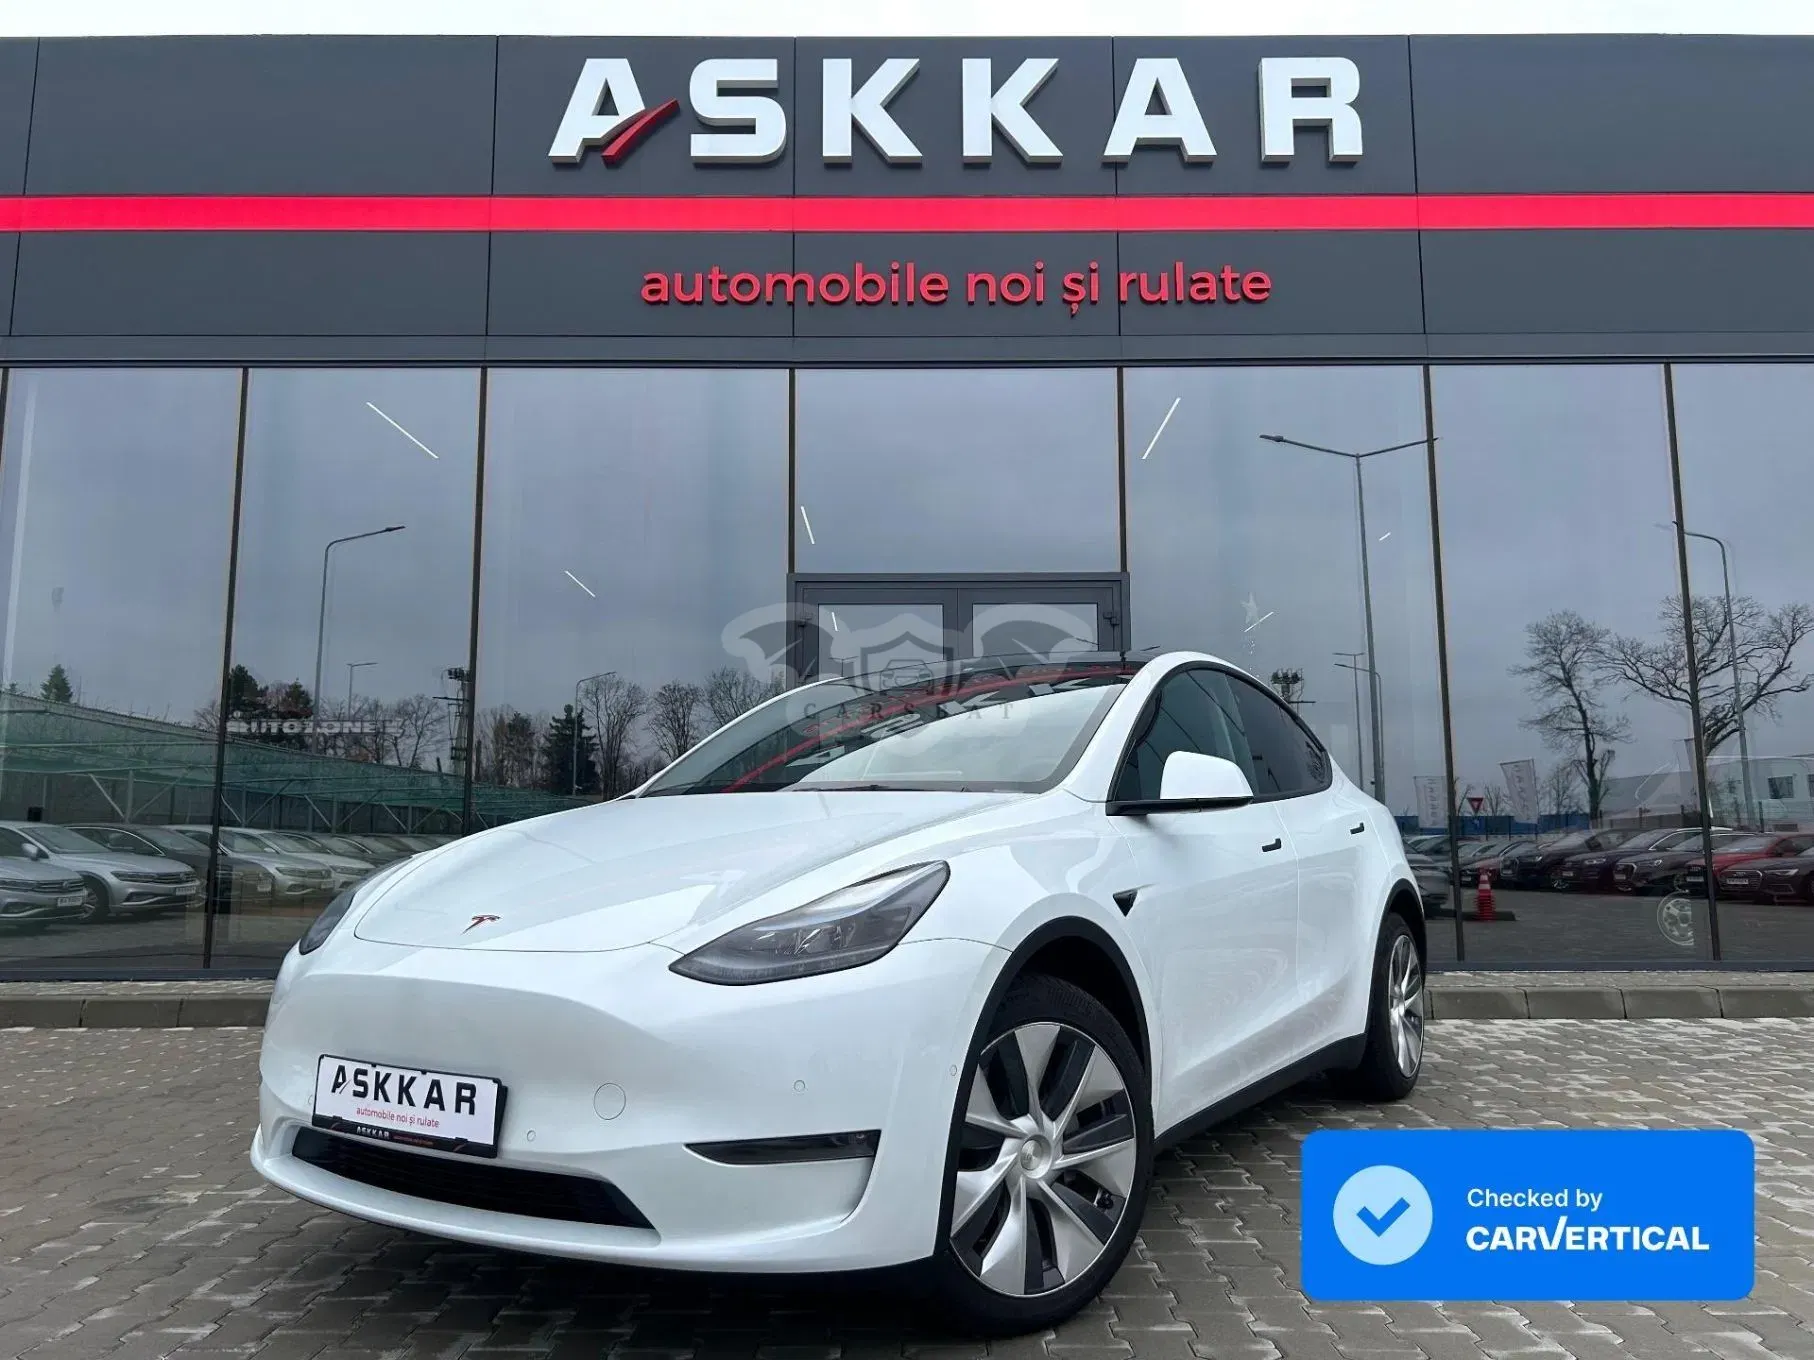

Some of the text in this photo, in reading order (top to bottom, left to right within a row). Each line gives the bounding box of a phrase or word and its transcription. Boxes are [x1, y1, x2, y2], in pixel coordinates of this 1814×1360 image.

[547, 57, 1364, 165] ASKKAR
[641, 261, 1272, 317] automobile noi și rulate
[331, 1064, 477, 1116] ASKKAR
[356, 1107, 395, 1121] automobile
[396, 1112, 408, 1123] noi
[416, 1116, 440, 1128] rulate
